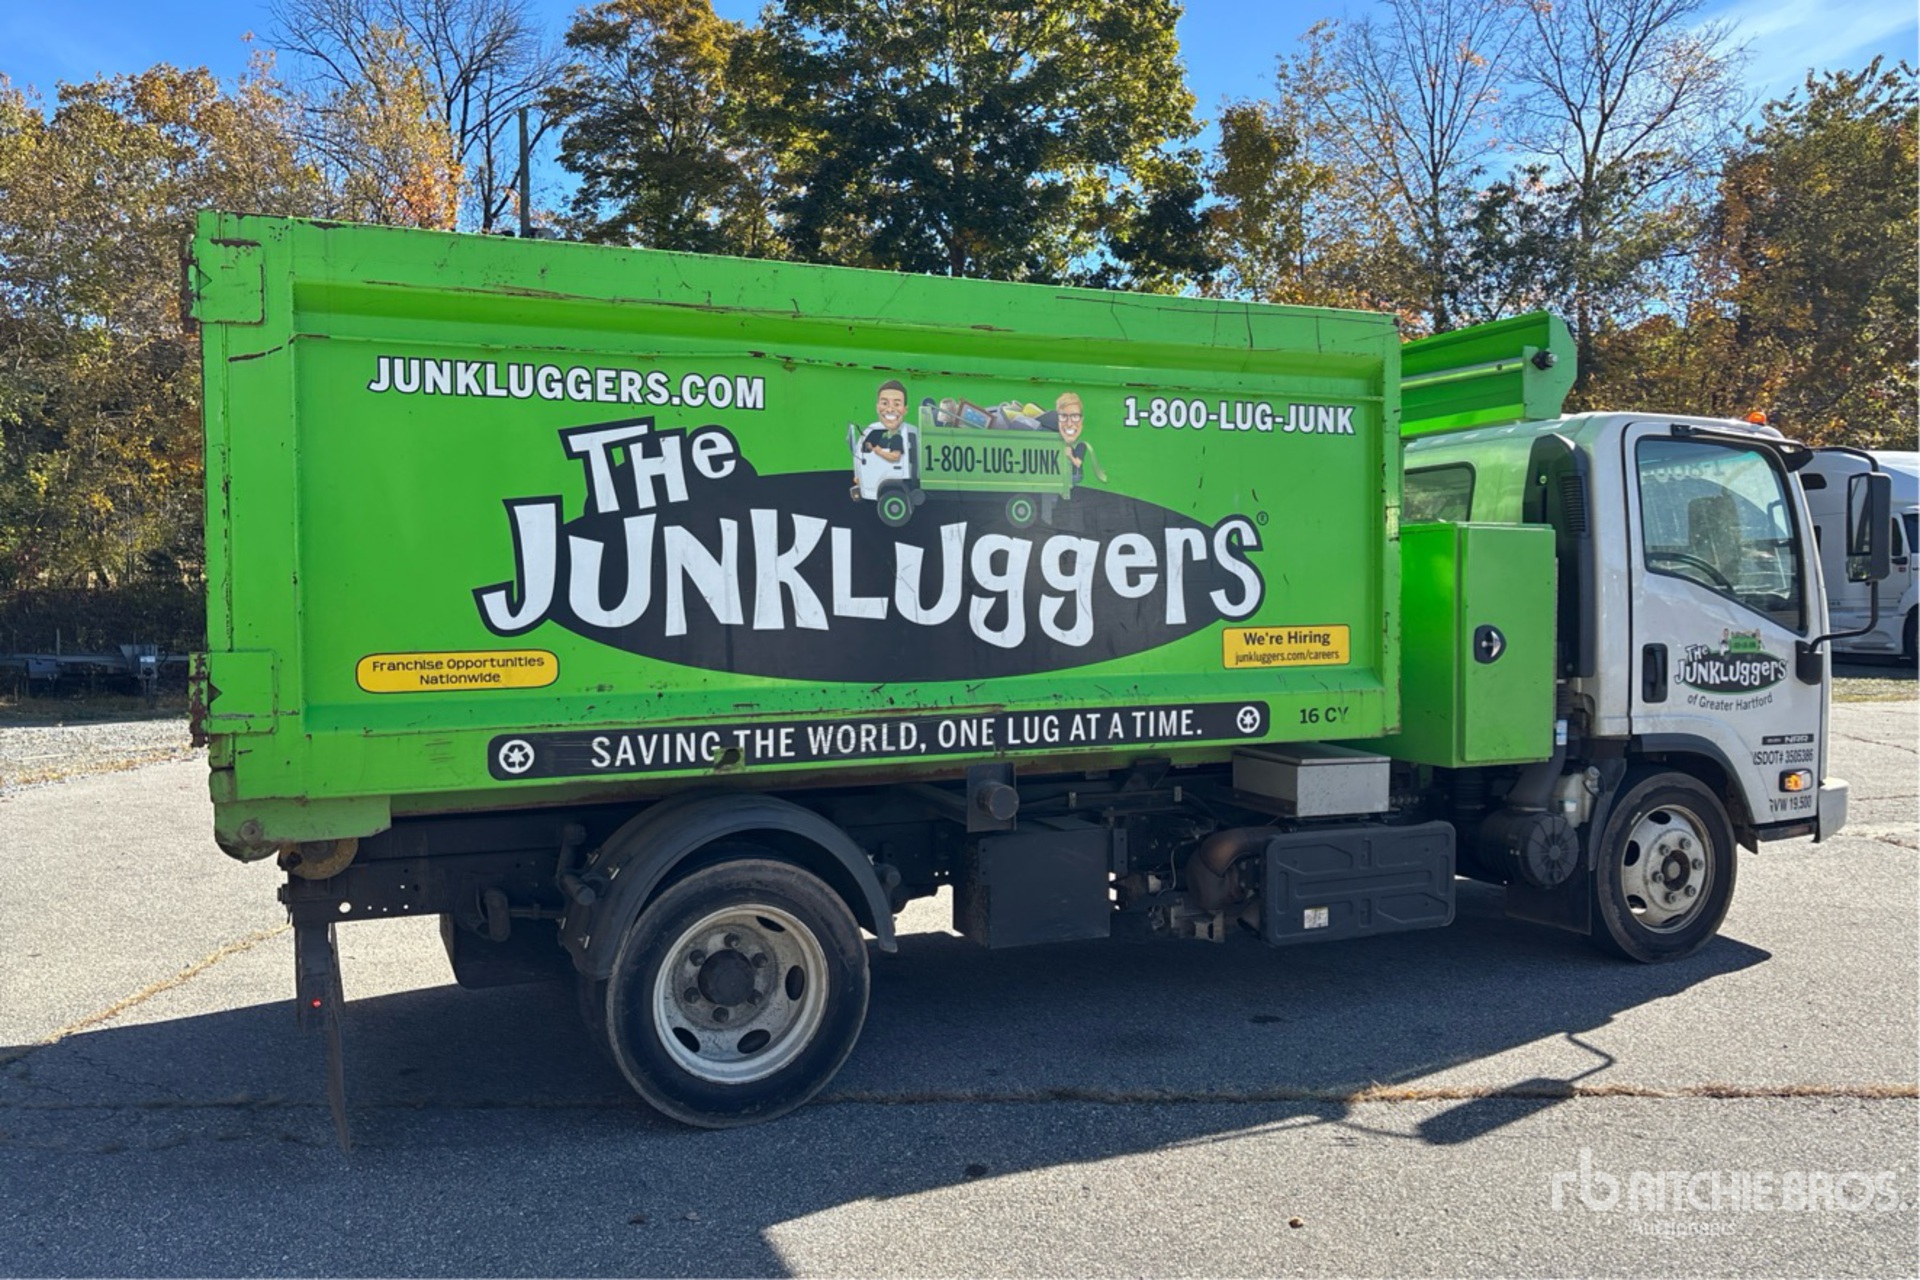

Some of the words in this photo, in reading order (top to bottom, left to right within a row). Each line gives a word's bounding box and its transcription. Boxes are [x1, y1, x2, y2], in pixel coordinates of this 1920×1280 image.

[368, 356, 765, 410] JUNKLUGGERS.COM
[1124, 397, 1356, 436] 1-800-LUG-JUNK
[924, 443, 1061, 476] 1-800-LUG-JUNK
[1243, 632, 1283, 646] We're
[1287, 631, 1331, 646] Hiring
[372, 659, 443, 672] Franchise
[447, 656, 545, 671] Opportunities
[1235, 649, 1340, 666] junkluggers.com/careers
[419, 672, 501, 686] Nationwide
[1687, 693, 1699, 706] of
[1699, 696, 1733, 711] Greater
[1735, 692, 1773, 711] Hartford
[1299, 707, 1320, 724] 16
[591, 731, 721, 769] SAVING
[733, 727, 795, 759] THE
[807, 722, 927, 755] WORLD,
[937, 717, 995, 748] ONE
[1007, 715, 1060, 745] LUG
[1070, 713, 1101, 741] AT
[1108, 713, 1124, 739] A
[1131, 709, 1203, 738] TIME.
